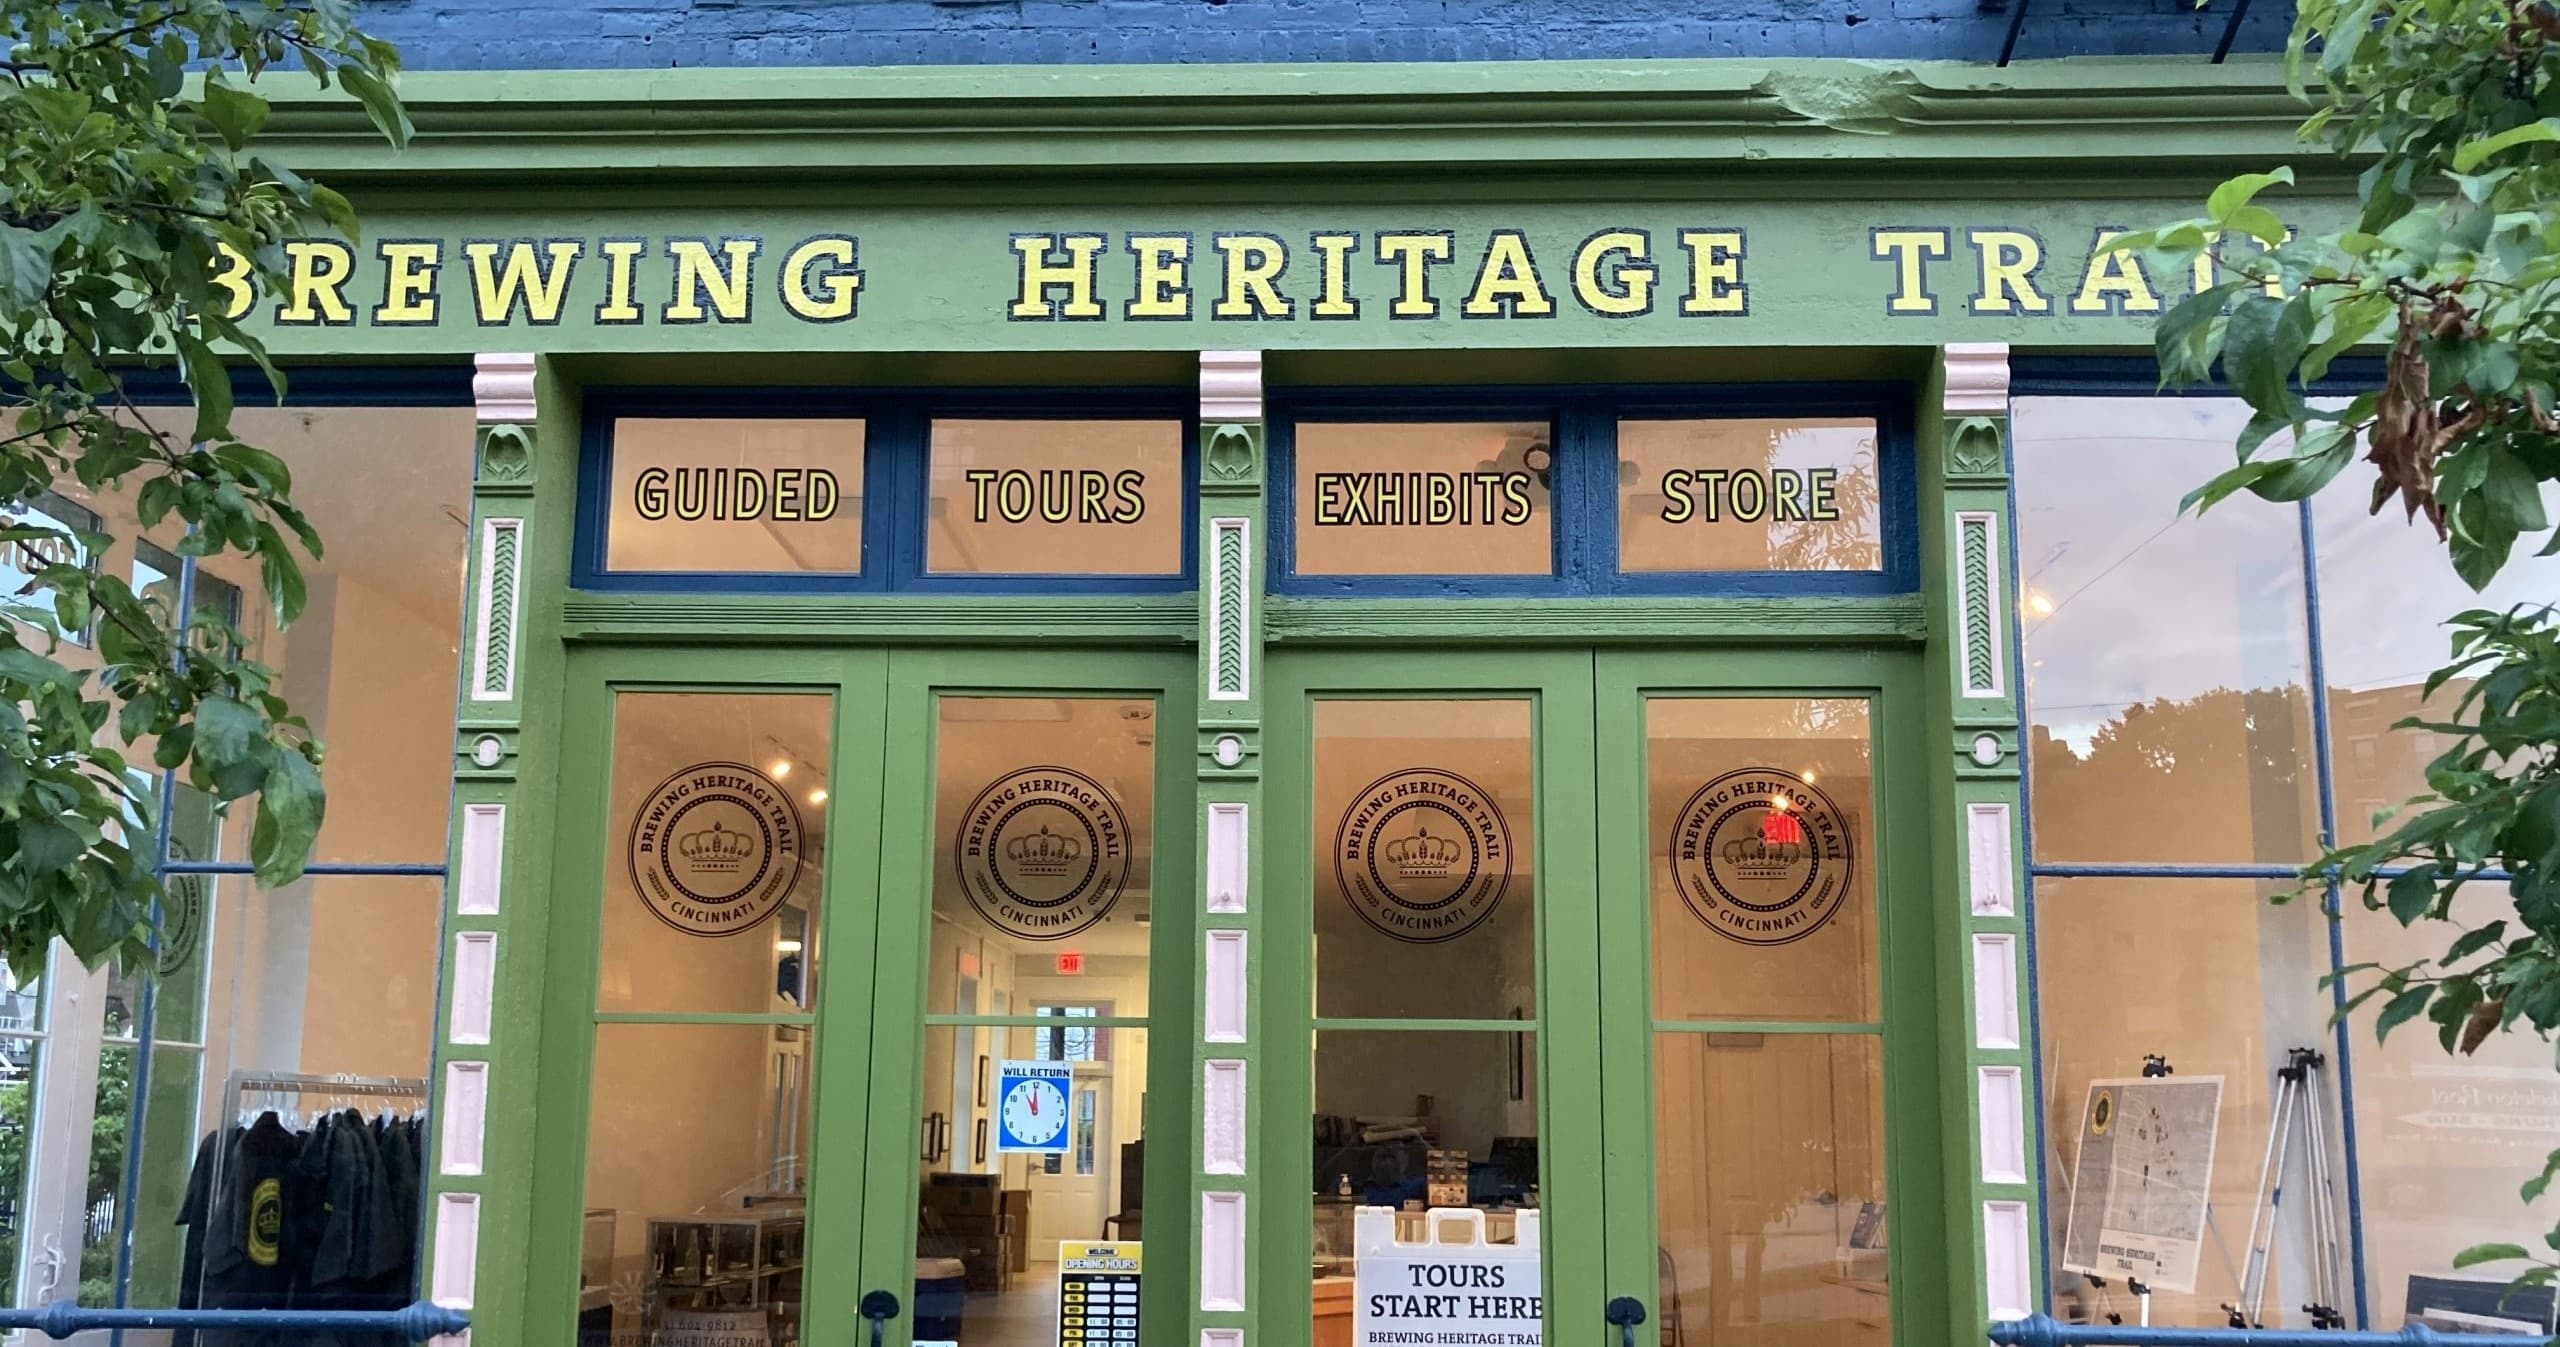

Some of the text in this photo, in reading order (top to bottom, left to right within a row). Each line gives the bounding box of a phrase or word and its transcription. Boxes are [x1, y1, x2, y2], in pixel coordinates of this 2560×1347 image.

[178, 233, 864, 327] BREWING
[1007, 226, 1748, 322] HERITAGE
[635, 468, 1145, 524] GUIDED TOURS
[1315, 472, 1531, 525] EXHIBITS
[1661, 468, 1839, 524] STORE
[641, 776, 792, 854] BREWING HERITAGE TRAIL
[968, 779, 1119, 858] BREWING HERITAGE TRAIL
[1347, 782, 1499, 859] BREWING HERITAGE TRAIL
[1683, 791, 1728, 860] BREWING
[1731, 781, 1817, 813] HERITAGE
[1814, 812, 1841, 860] TRAIL
[671, 902, 755, 923] CINCINNATI
[1000, 905, 1084, 926] CINCINNATI
[1381, 908, 1467, 929] CINCINNATI
[1720, 909, 1808, 931] CINCINNATI
[1003, 1067, 1070, 1077] WILL RETURN
[1066, 1258, 1137, 1270] OPENING HOURS
[1408, 1264, 1505, 1288] TOURS
[1370, 1295, 1460, 1318] START
[1369, 1332, 1433, 1344] BREWING
[1437, 1333, 1504, 1345] HERITAGE
